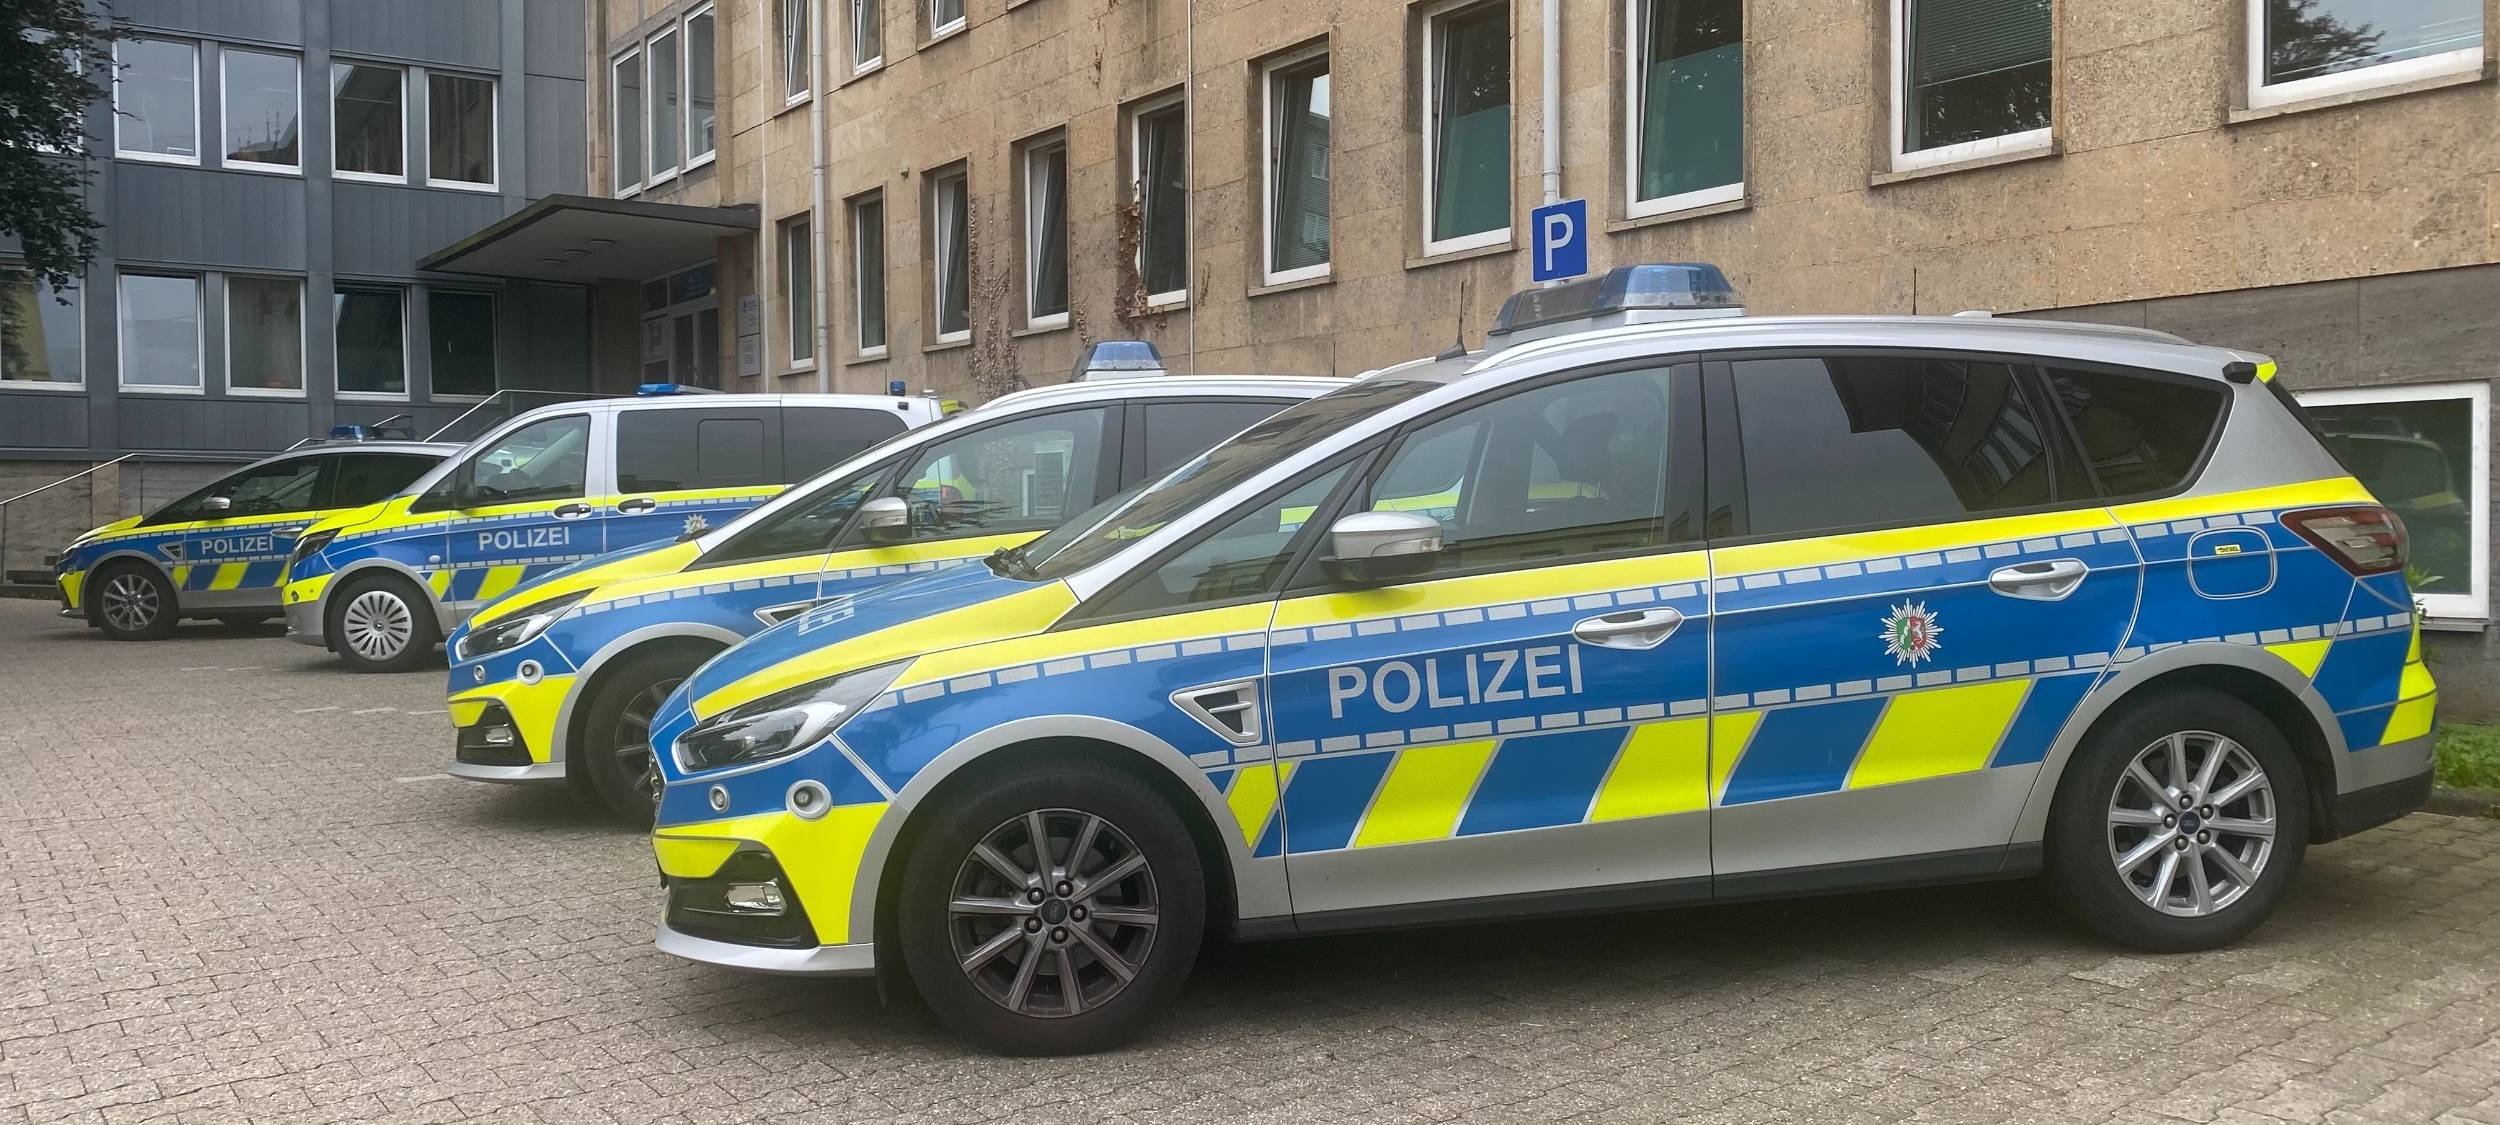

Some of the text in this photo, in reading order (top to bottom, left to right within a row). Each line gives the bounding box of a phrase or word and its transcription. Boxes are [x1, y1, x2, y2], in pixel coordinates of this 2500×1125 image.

[1544, 213, 1574, 271] P
[201, 536, 274, 554] POLIZEI
[478, 526, 570, 551] POLIZEI
[1328, 643, 1583, 719] POLIZEI
